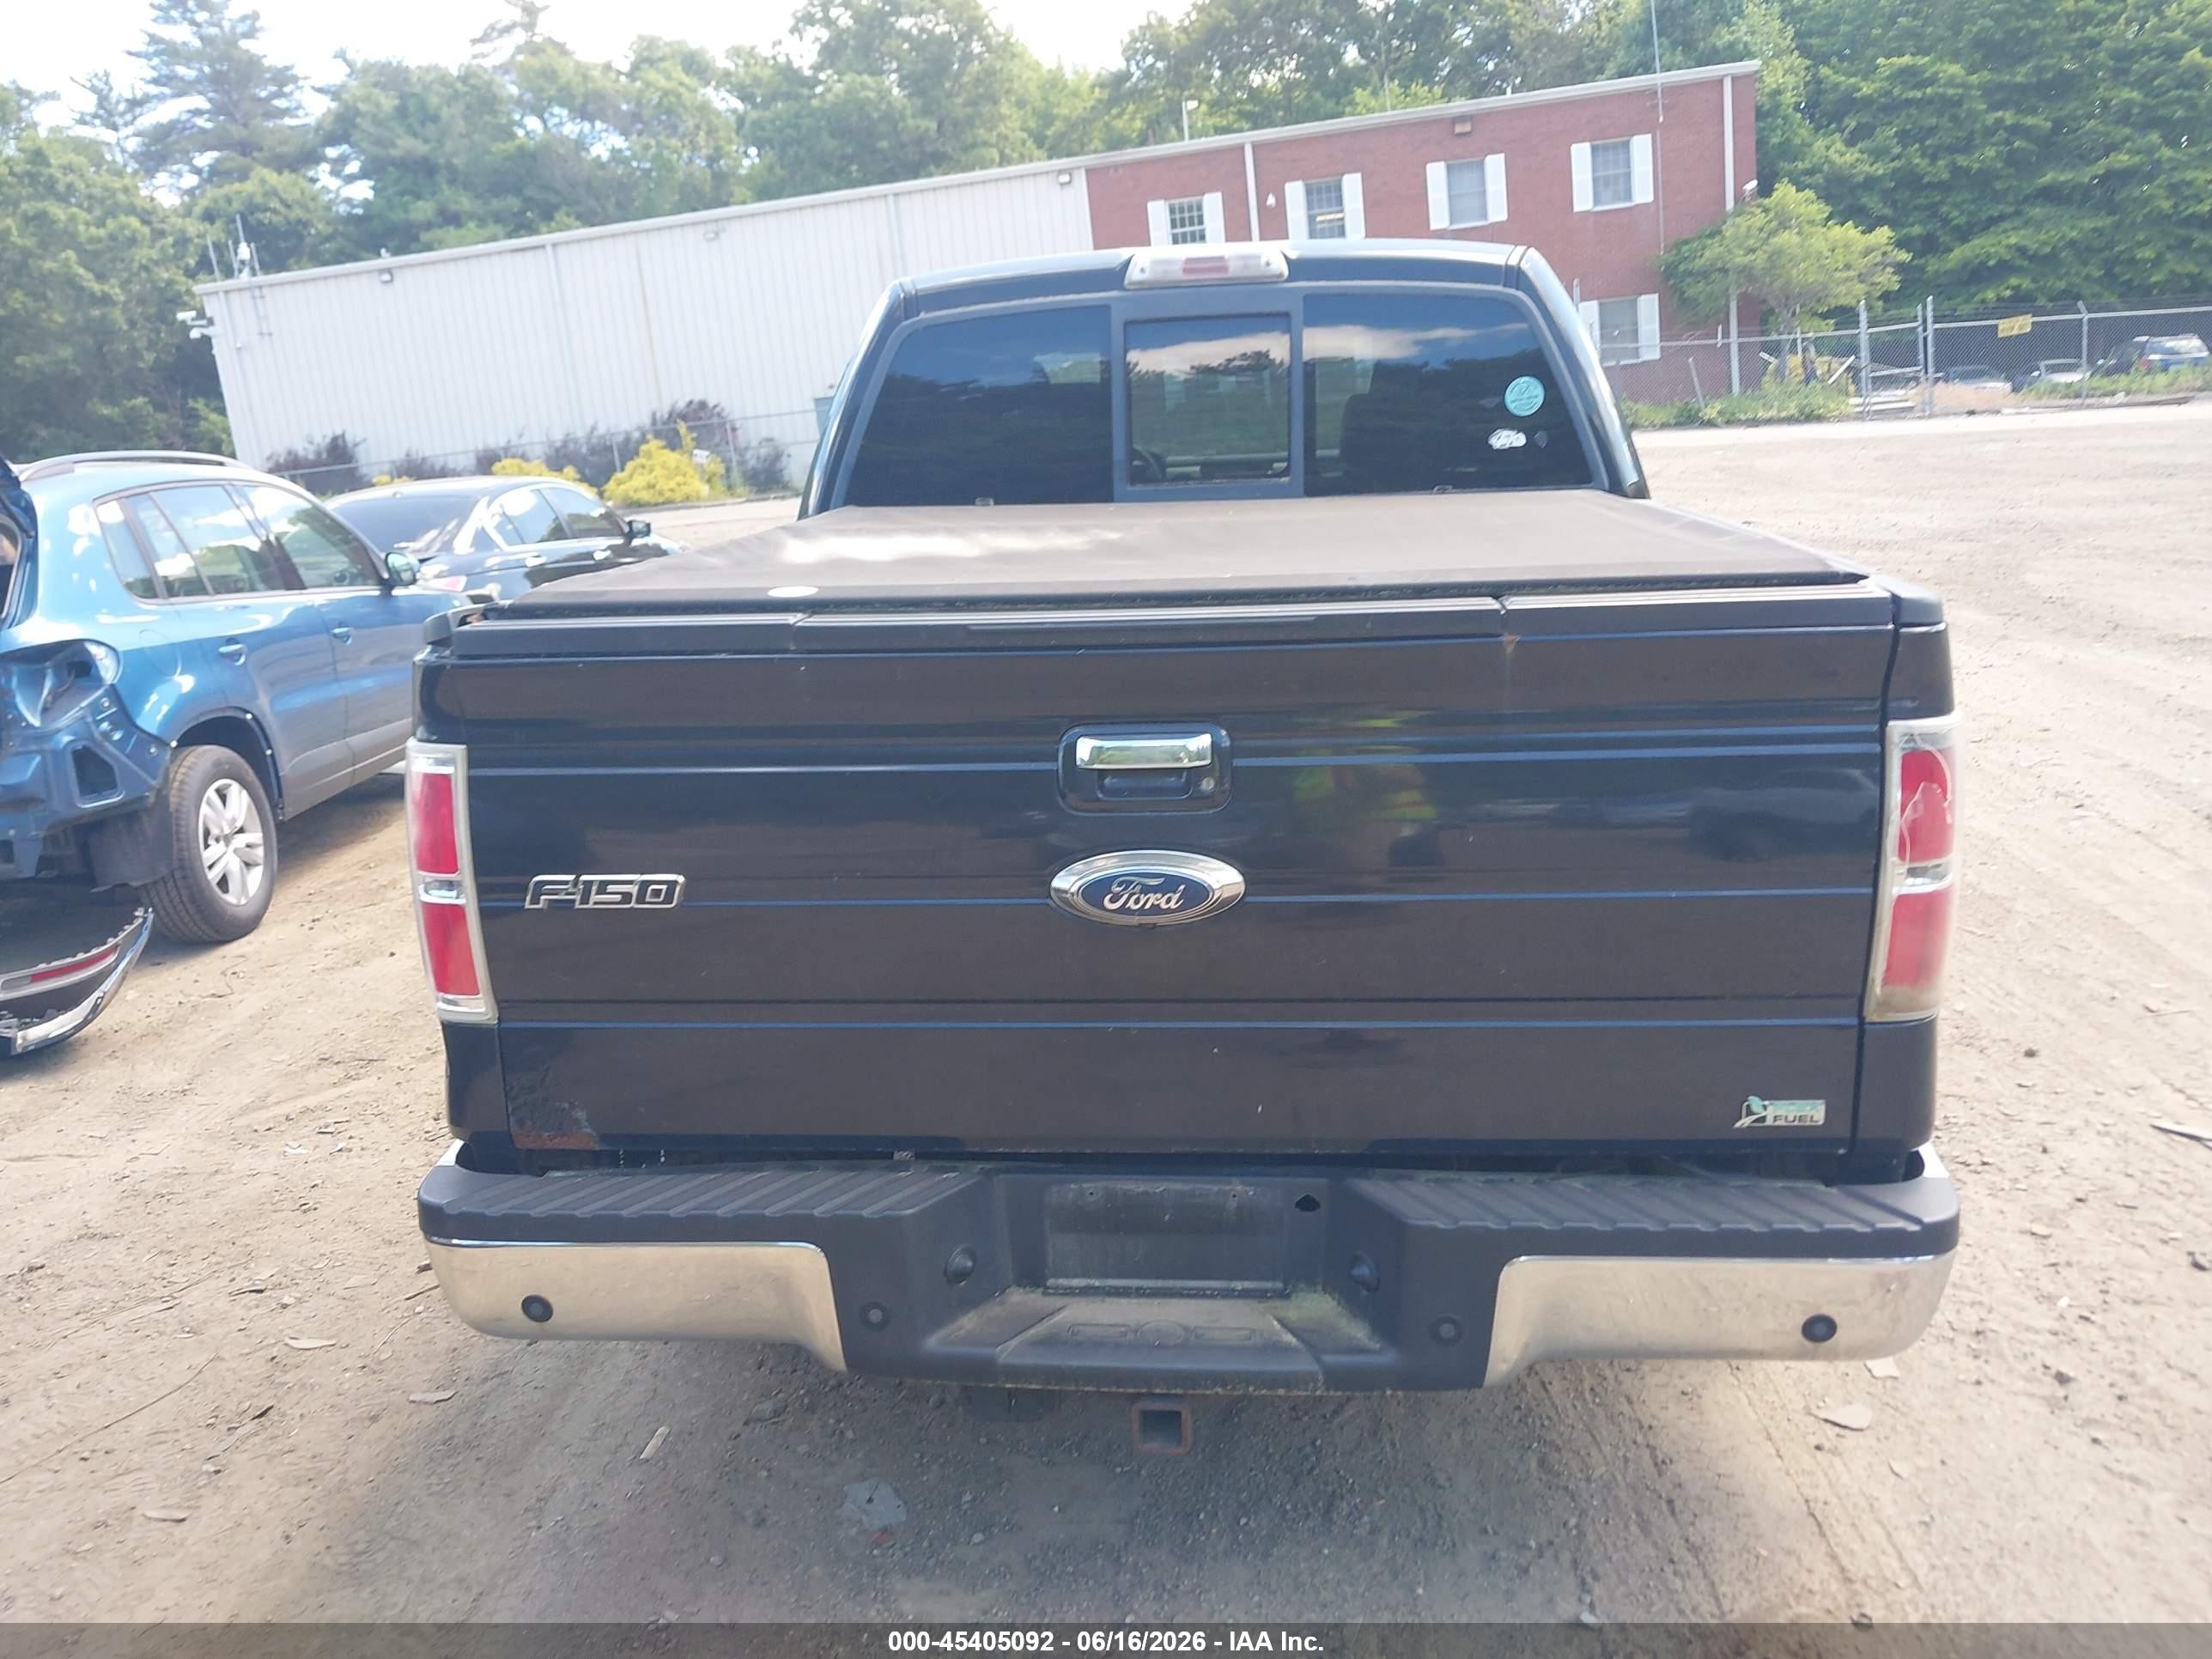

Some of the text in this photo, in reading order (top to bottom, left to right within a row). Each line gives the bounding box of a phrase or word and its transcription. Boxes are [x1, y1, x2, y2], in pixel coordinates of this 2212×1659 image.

[524, 873, 686, 909] F-150
[1103, 876, 1186, 910] Ford
[1772, 1114, 1820, 1124] FUEL
